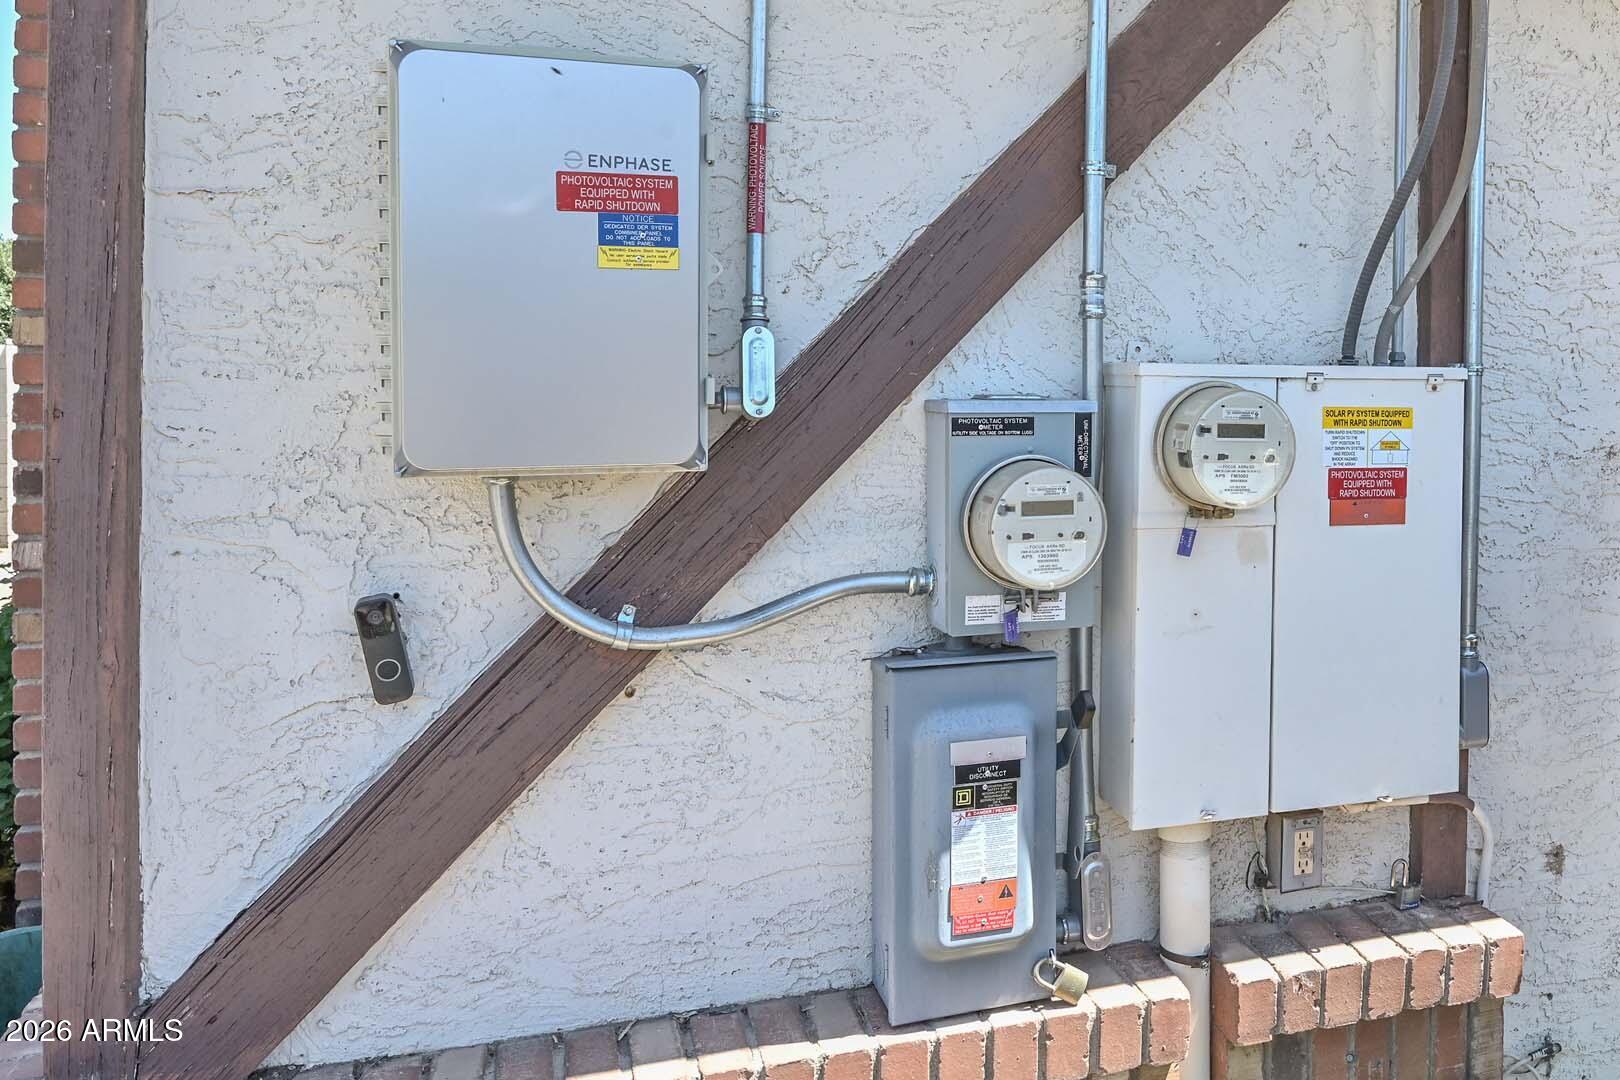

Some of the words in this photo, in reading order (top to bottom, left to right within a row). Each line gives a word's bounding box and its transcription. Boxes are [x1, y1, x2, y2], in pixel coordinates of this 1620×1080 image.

[588, 154, 672, 172] ENPHASE
[749, 124, 759, 188] PHOTOVOLTAIC
[560, 174, 633, 188] PHOTOVOLTAIC
[635, 178, 672, 189] SYSTEM
[580, 188, 628, 199] EQUIPPED
[631, 190, 654, 200] WITH
[574, 199, 603, 210] RAPID
[606, 201, 660, 212] SHUTDOWN
[622, 214, 654, 222] NOTICE
